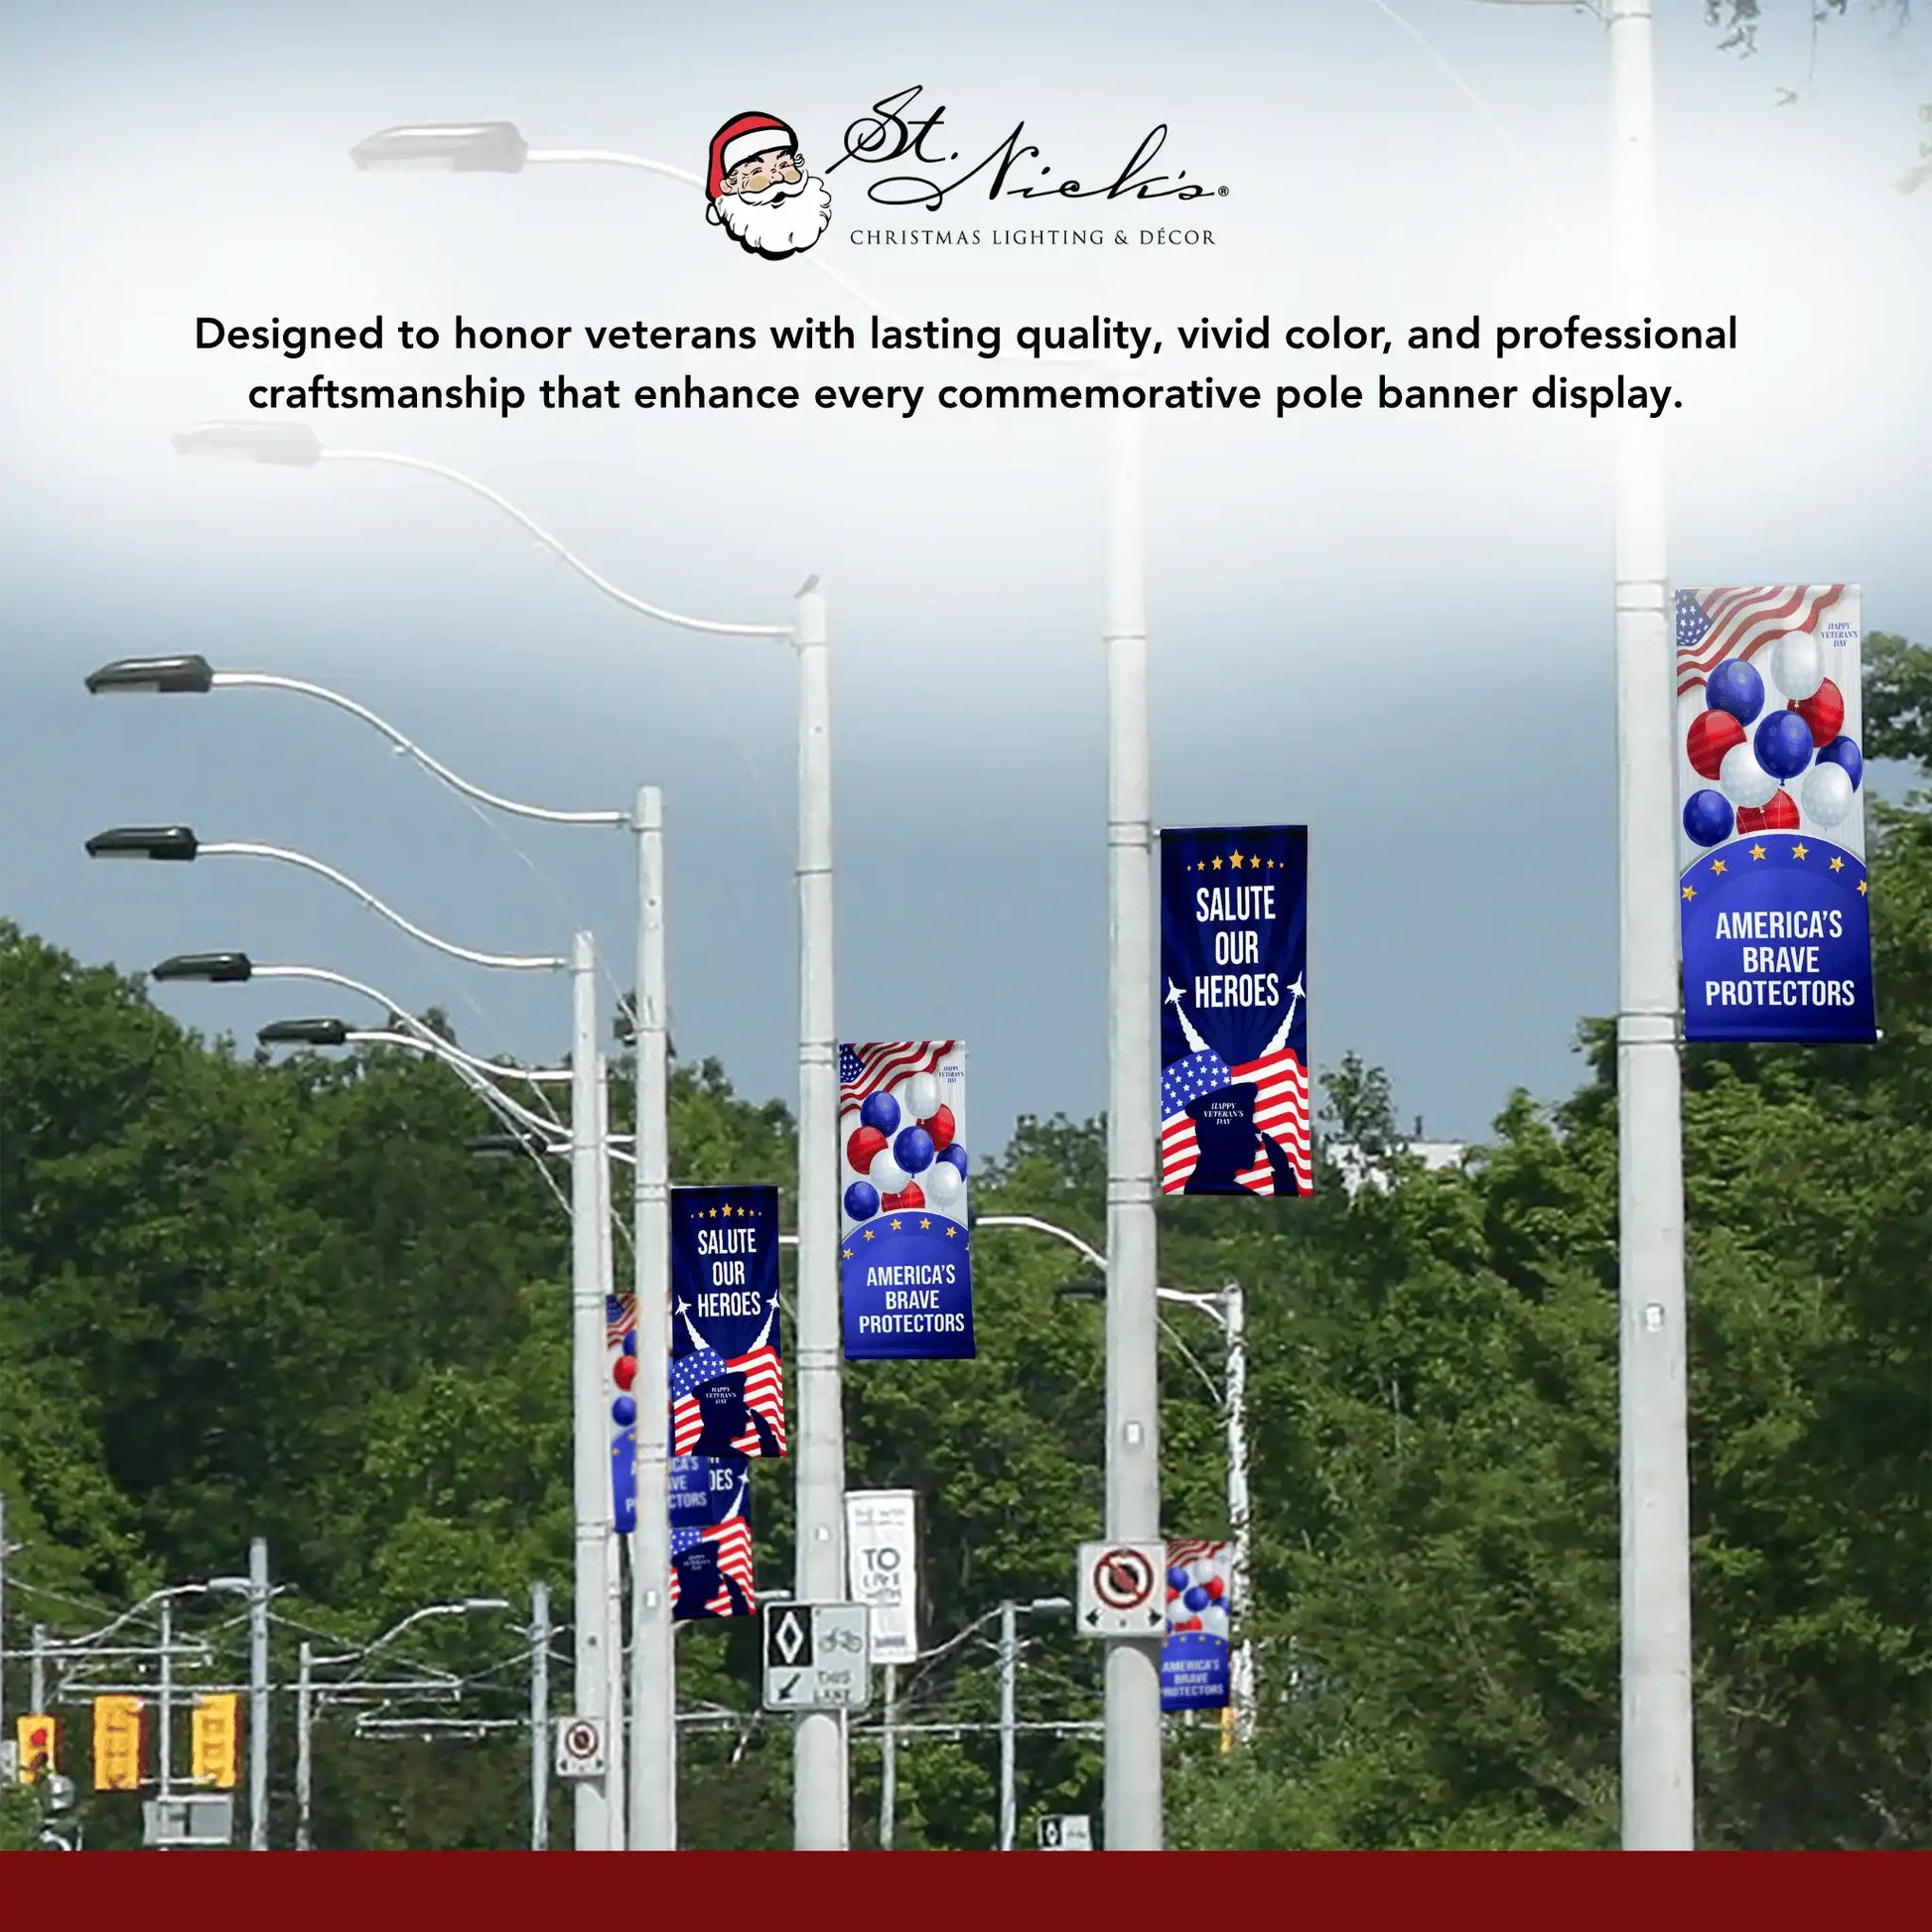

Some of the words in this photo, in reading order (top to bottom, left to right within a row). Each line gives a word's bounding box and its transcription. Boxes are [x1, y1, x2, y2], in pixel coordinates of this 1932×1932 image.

[1195, 885, 1277, 922] SALUTE
[1716, 909, 1843, 939] AMERICA'S
[1215, 930, 1259, 966] OUR
[1742, 946, 1820, 973] BRAVE
[1194, 973, 1280, 1009] HEROES
[1706, 980, 1855, 1007] PROTECTORS
[697, 1227, 758, 1256] SALUTE
[712, 1260, 746, 1287] OUR
[866, 1264, 956, 1288] AMERICA'S
[697, 1291, 761, 1318] HEROES
[885, 1290, 940, 1311] BRAVE
[859, 1312, 965, 1334] PROTECTORS
[862, 1547, 900, 1572] TO
